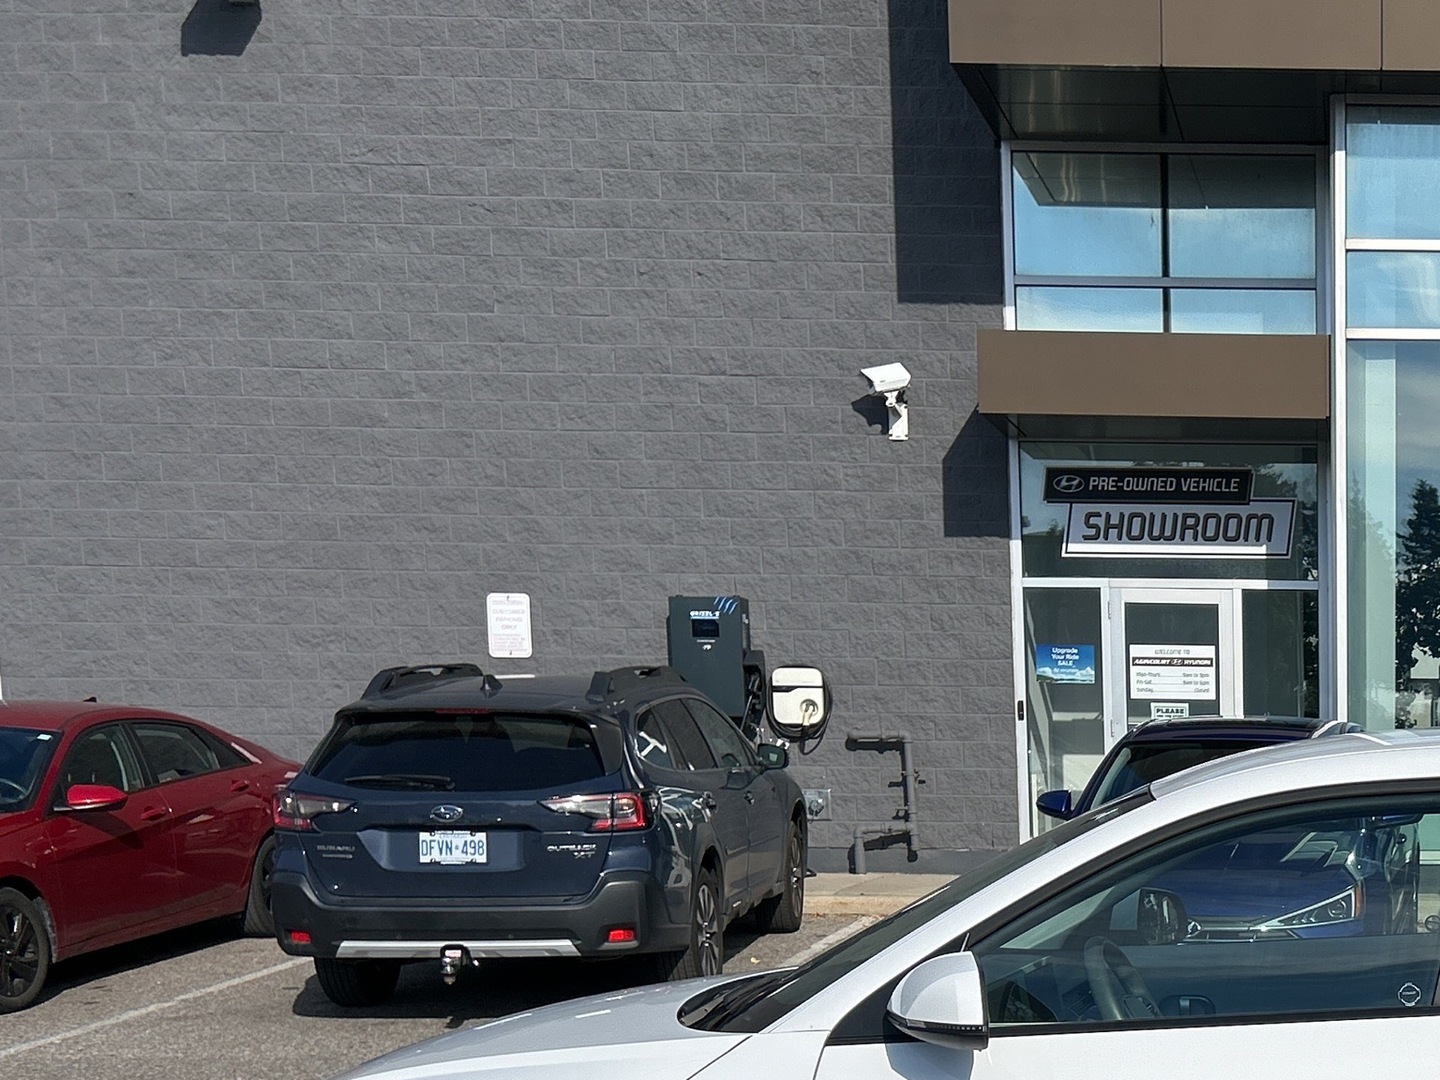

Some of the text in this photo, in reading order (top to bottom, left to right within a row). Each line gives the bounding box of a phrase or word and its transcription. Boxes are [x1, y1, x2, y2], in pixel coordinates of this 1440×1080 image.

[1088, 476, 1240, 492] PRE-OWNED VEHICLE
[1081, 511, 1275, 542] SHOWROOM
[1052, 647, 1079, 655] Upgrade
[421, 839, 485, 857] DFVN 498
